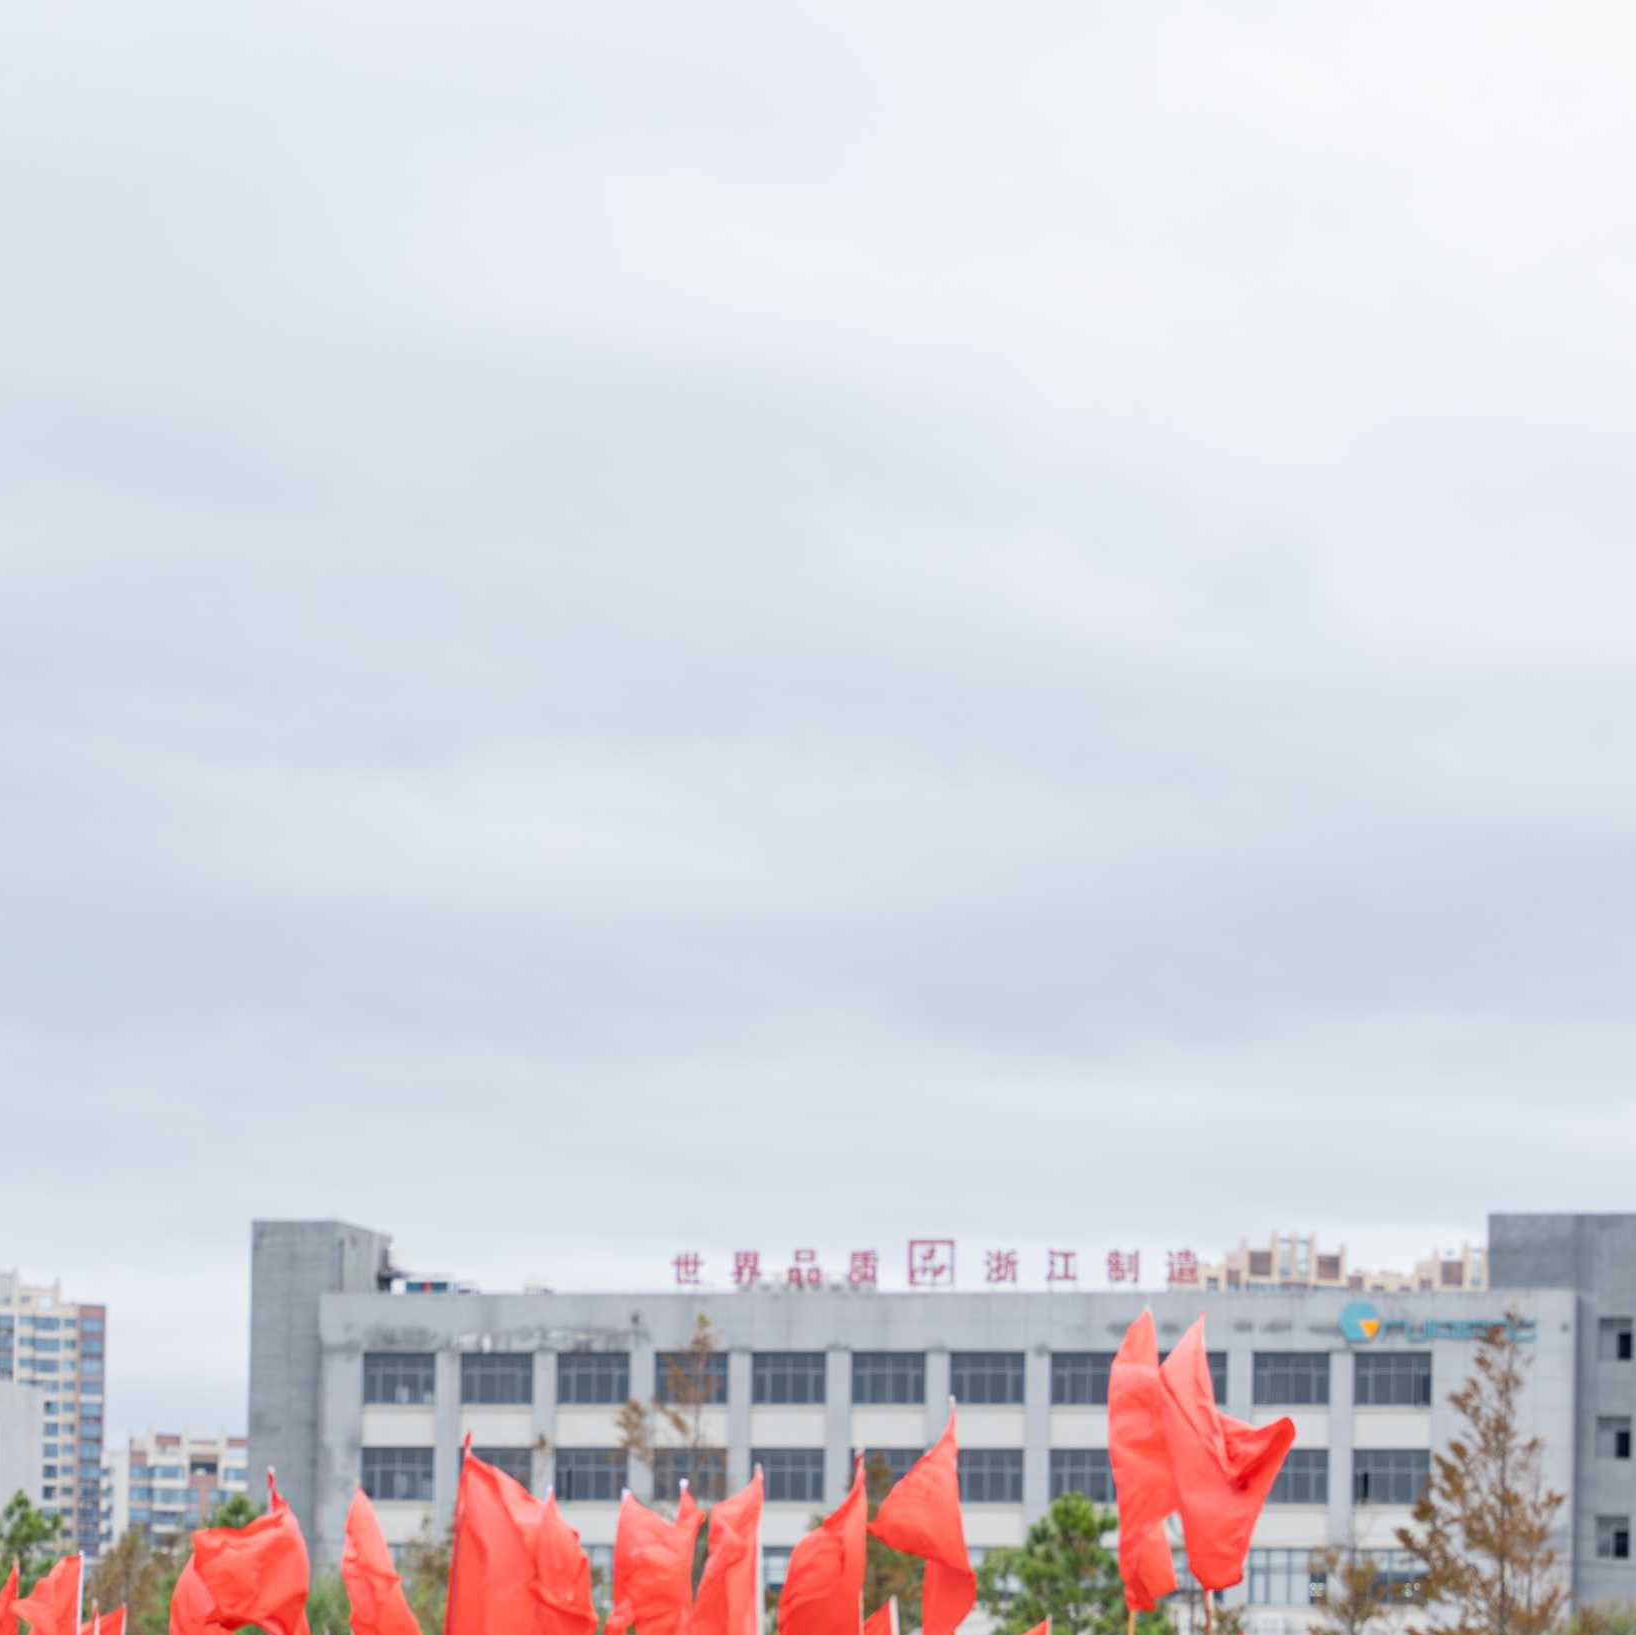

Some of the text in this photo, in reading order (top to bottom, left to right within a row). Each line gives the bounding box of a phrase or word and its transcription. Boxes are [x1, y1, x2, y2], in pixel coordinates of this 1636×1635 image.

[671, 1248, 1200, 1286] 世界品质 浙江制造
